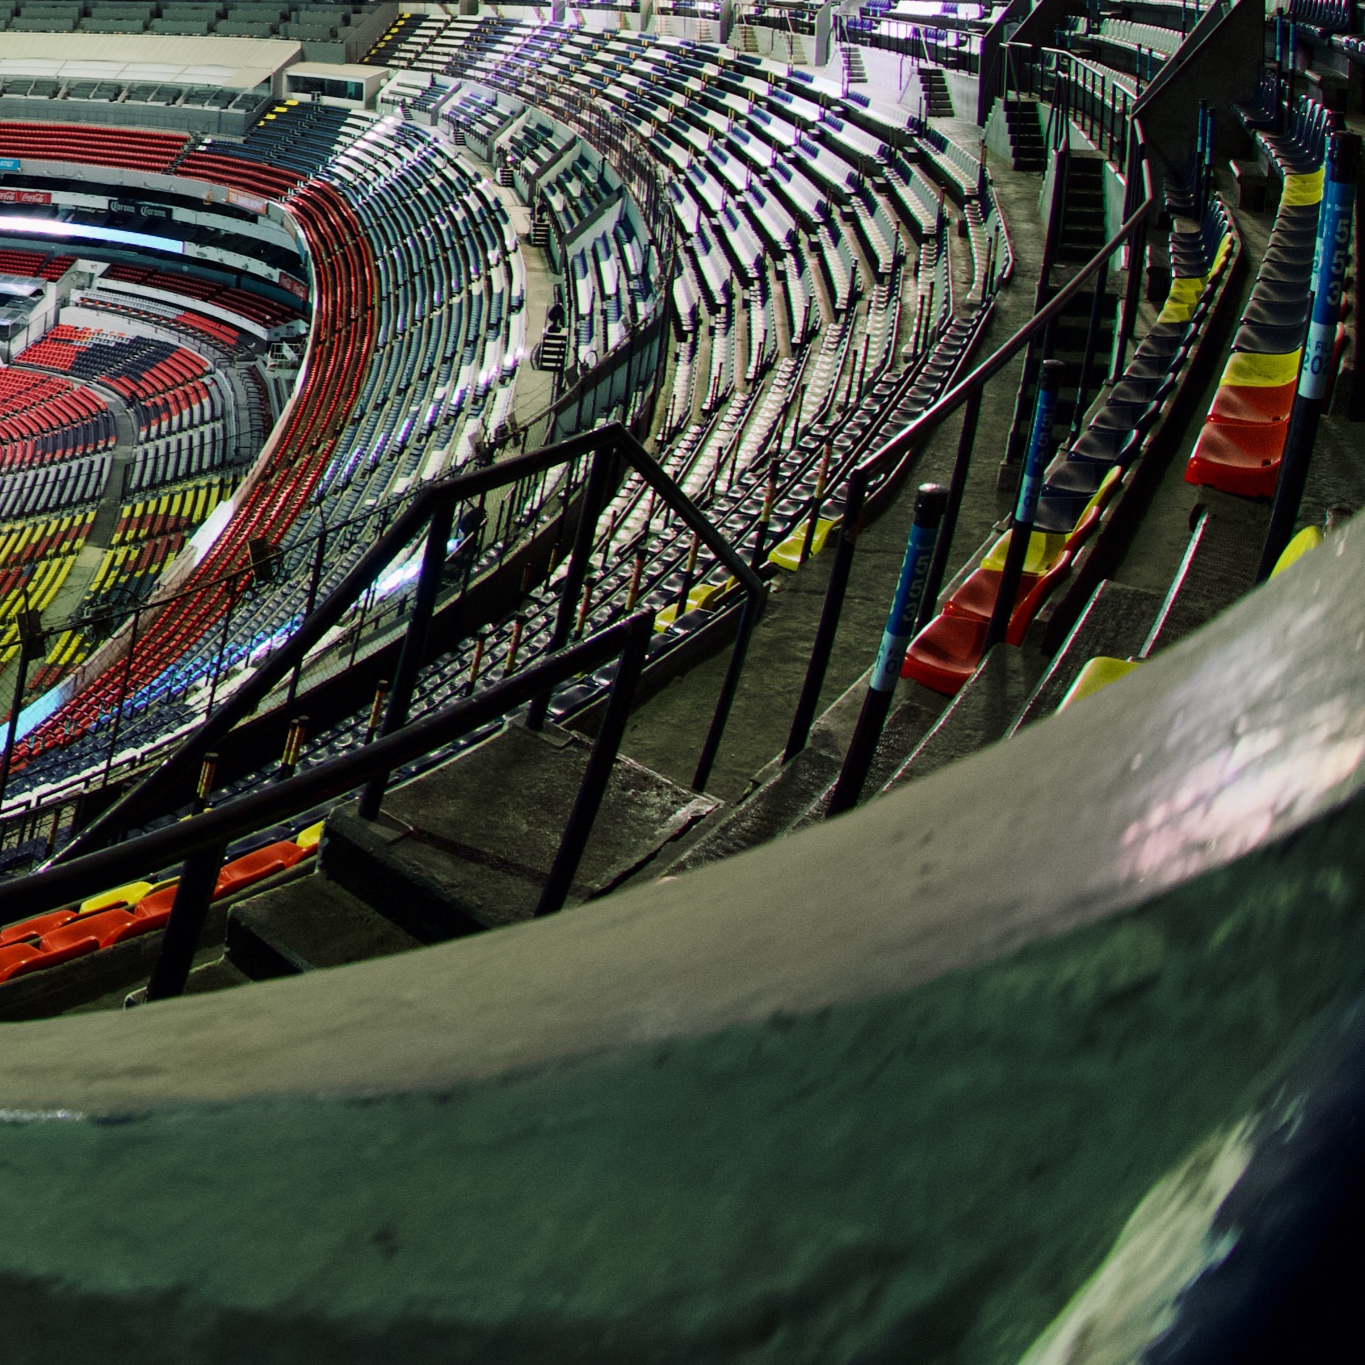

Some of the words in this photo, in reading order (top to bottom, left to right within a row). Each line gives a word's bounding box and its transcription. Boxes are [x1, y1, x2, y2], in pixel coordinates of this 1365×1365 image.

[110, 200, 135, 213] Corona
[140, 205, 166, 218] Corona
[901, 554, 931, 623] 553
